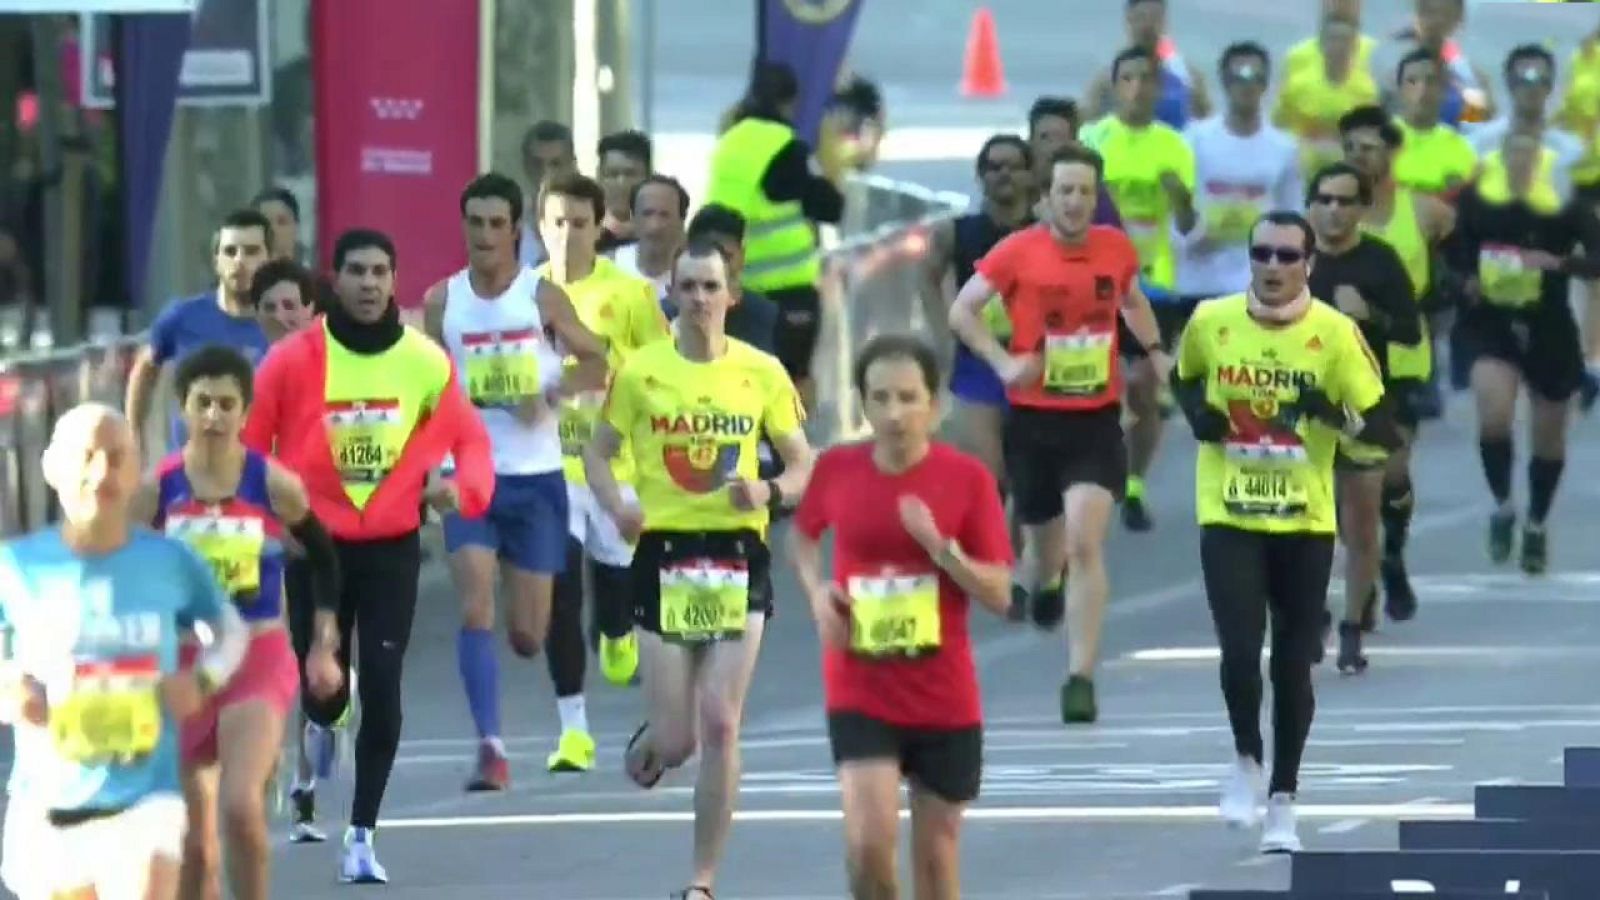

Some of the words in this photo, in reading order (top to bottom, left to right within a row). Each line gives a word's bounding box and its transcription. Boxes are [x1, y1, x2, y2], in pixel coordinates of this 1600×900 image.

[1217, 365, 1316, 389] MADRID
[650, 414, 755, 436] MADRID
[1244, 475, 1287, 497] 44014
